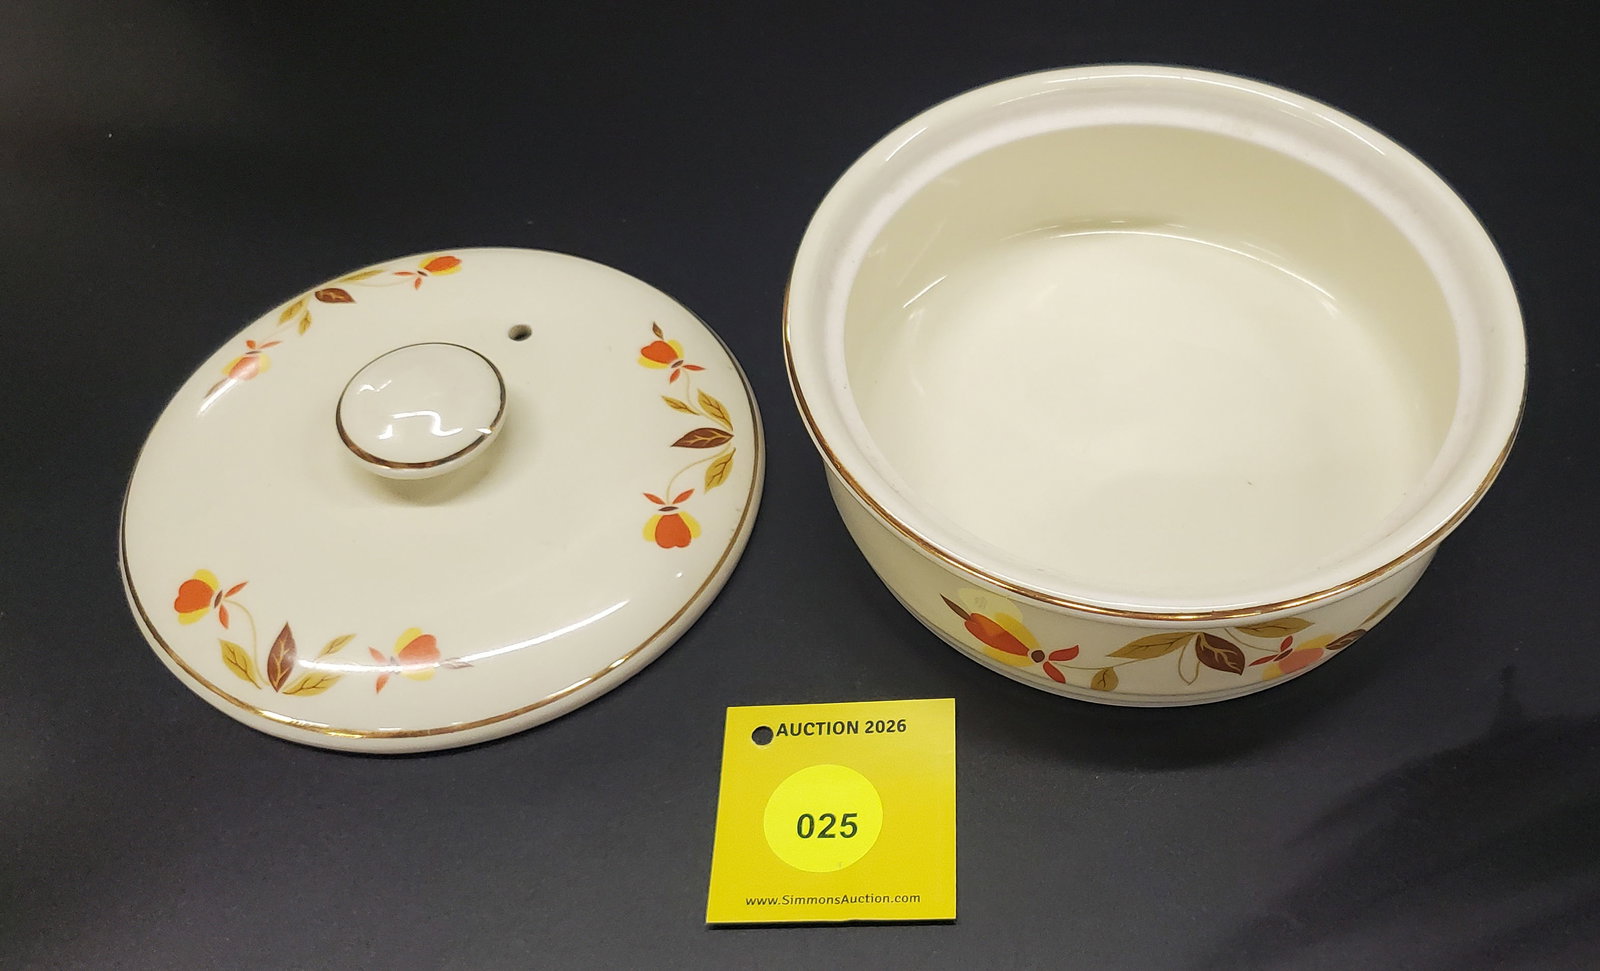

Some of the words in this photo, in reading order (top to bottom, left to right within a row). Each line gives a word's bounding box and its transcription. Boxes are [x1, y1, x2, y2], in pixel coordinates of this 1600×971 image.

[775, 720, 859, 737] AUCTION
[864, 719, 907, 735] 2026
[796, 813, 858, 839] 025
[745, 893, 921, 906] www.SimmonsAuction.com
